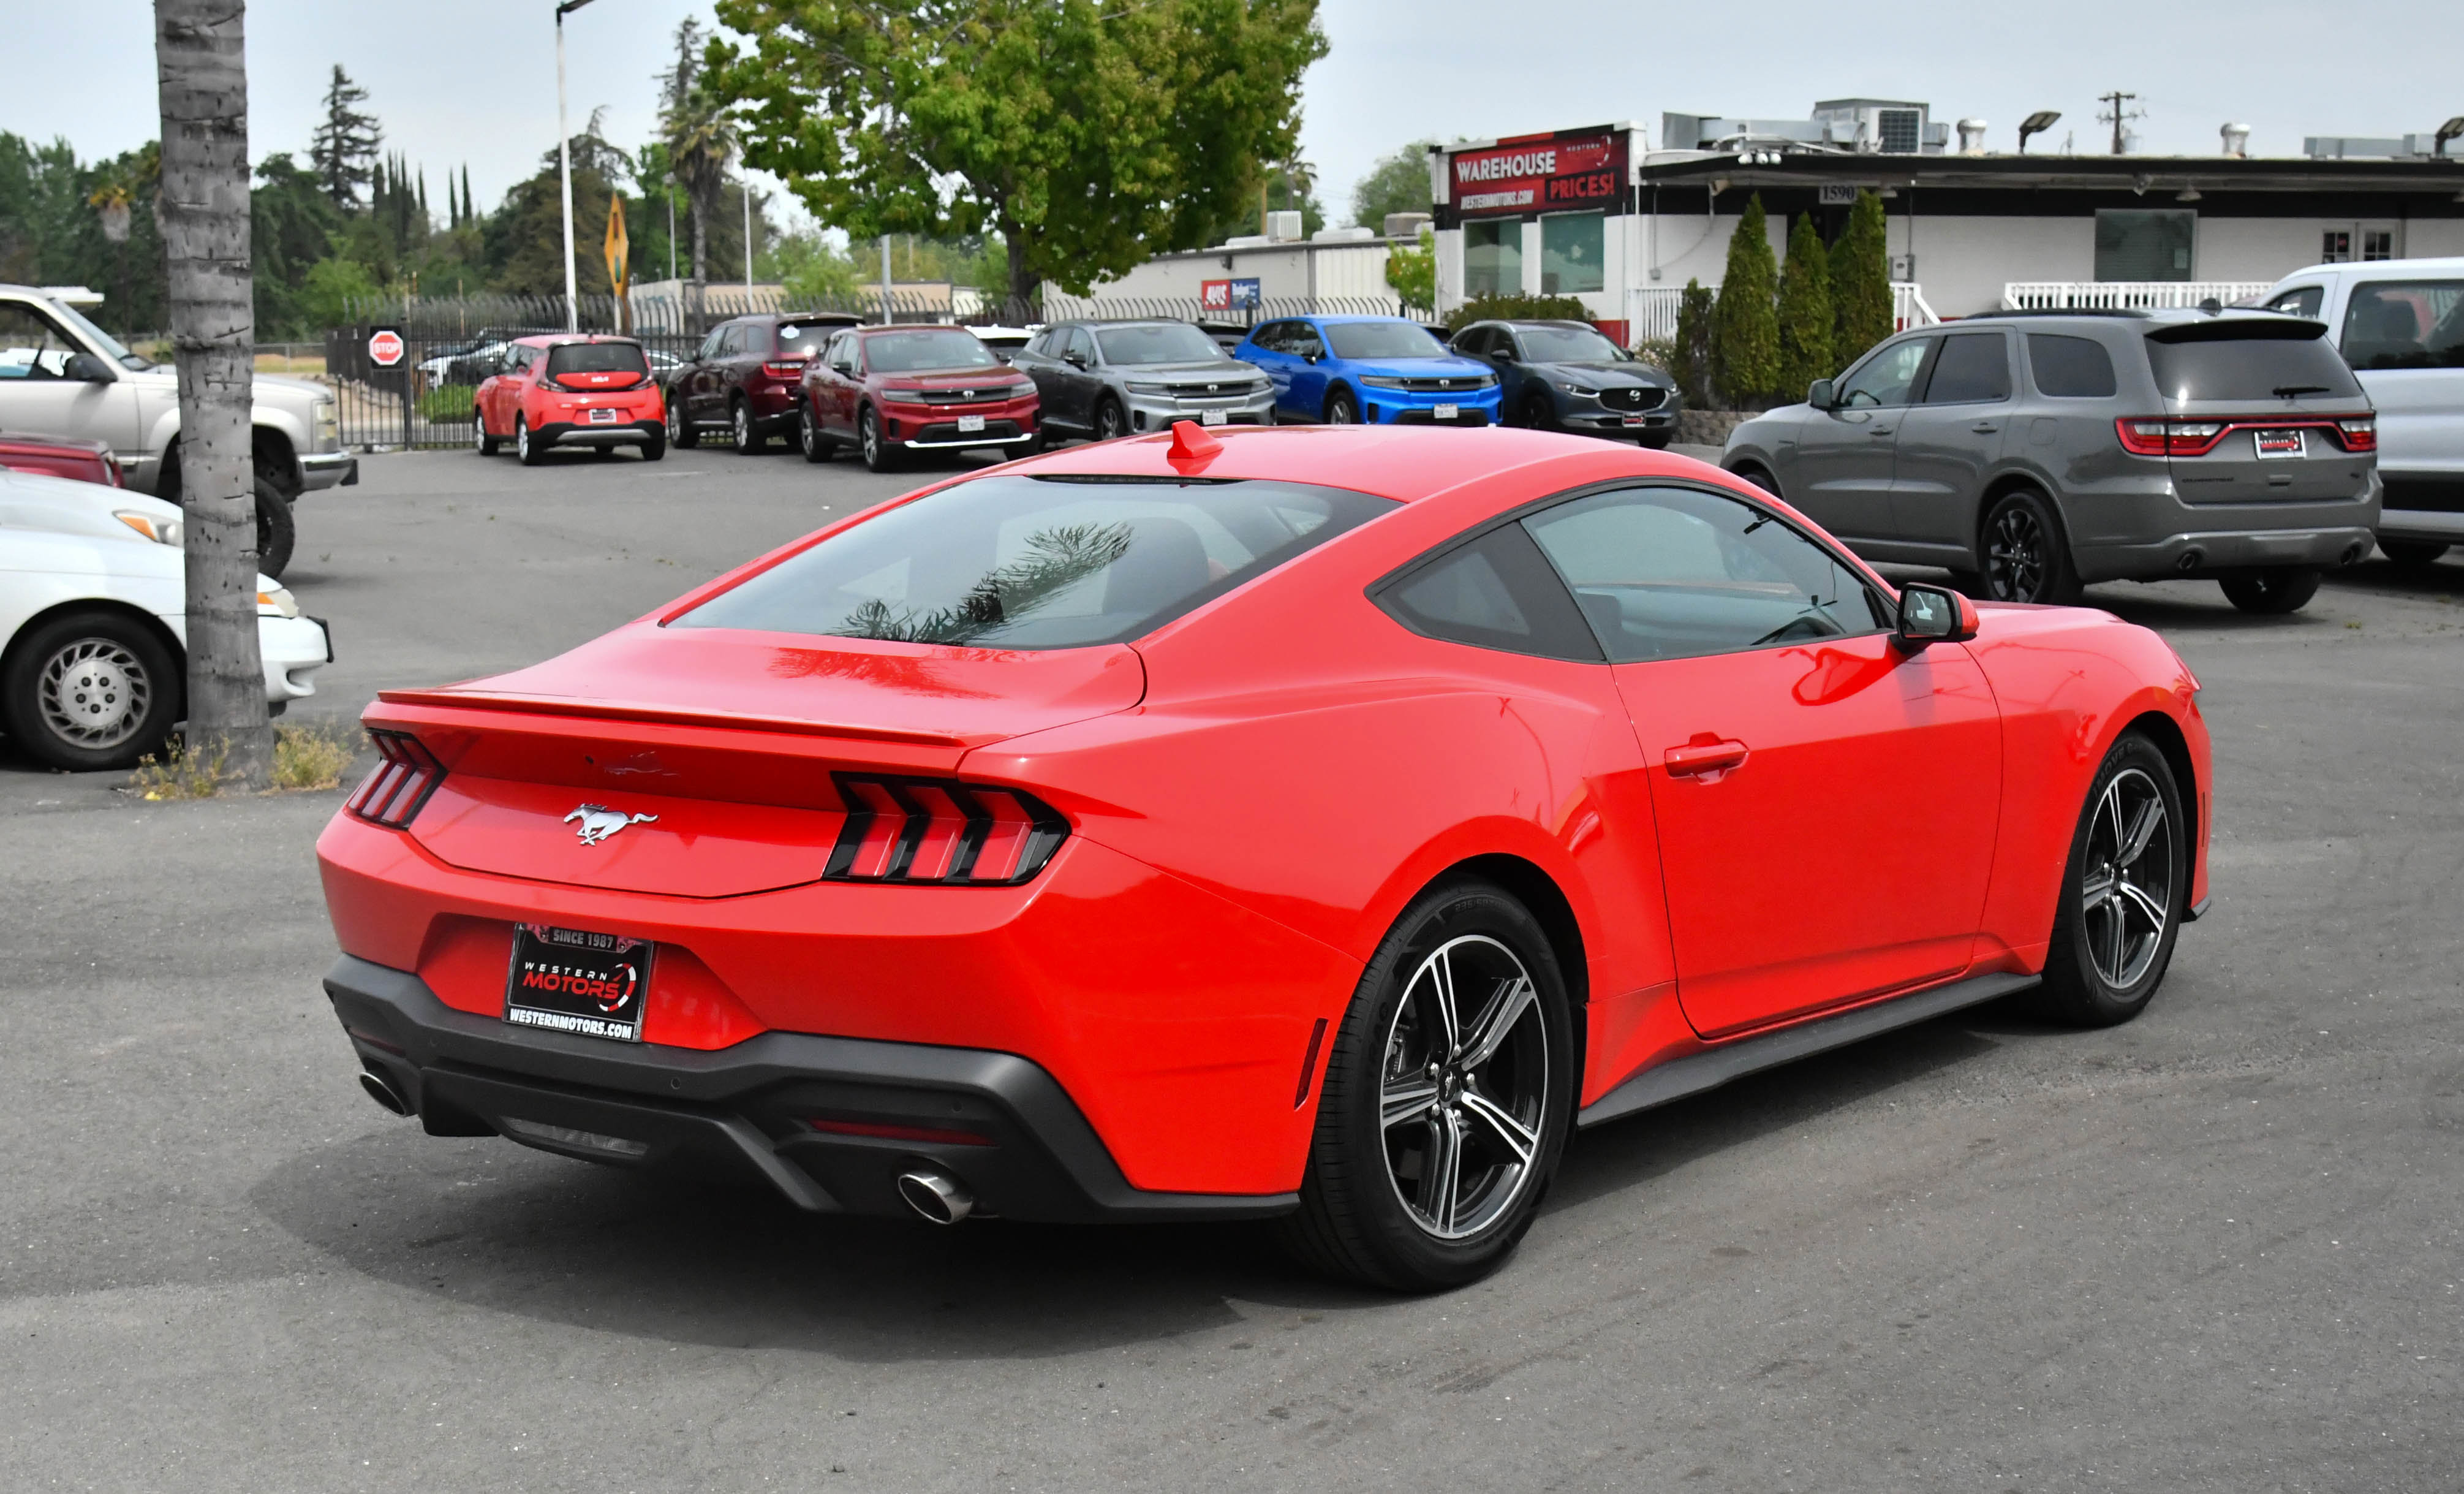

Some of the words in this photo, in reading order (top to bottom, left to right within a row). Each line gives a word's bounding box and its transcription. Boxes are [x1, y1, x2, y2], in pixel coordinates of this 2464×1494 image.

[1456, 151, 1556, 183] WAREHOUSE
[1550, 172, 1615, 199] PRICES!
[1823, 185, 1854, 201] 1590
[1204, 284, 1227, 305] AVIS
[372, 342, 399, 354] STOP
[553, 929, 583, 944] SINCE
[588, 933, 613, 948] 1987
[524, 961, 607, 980] WESTERN
[523, 971, 621, 1000] MOTORS
[510, 1008, 632, 1039] WESTERNMOTORS.COM
